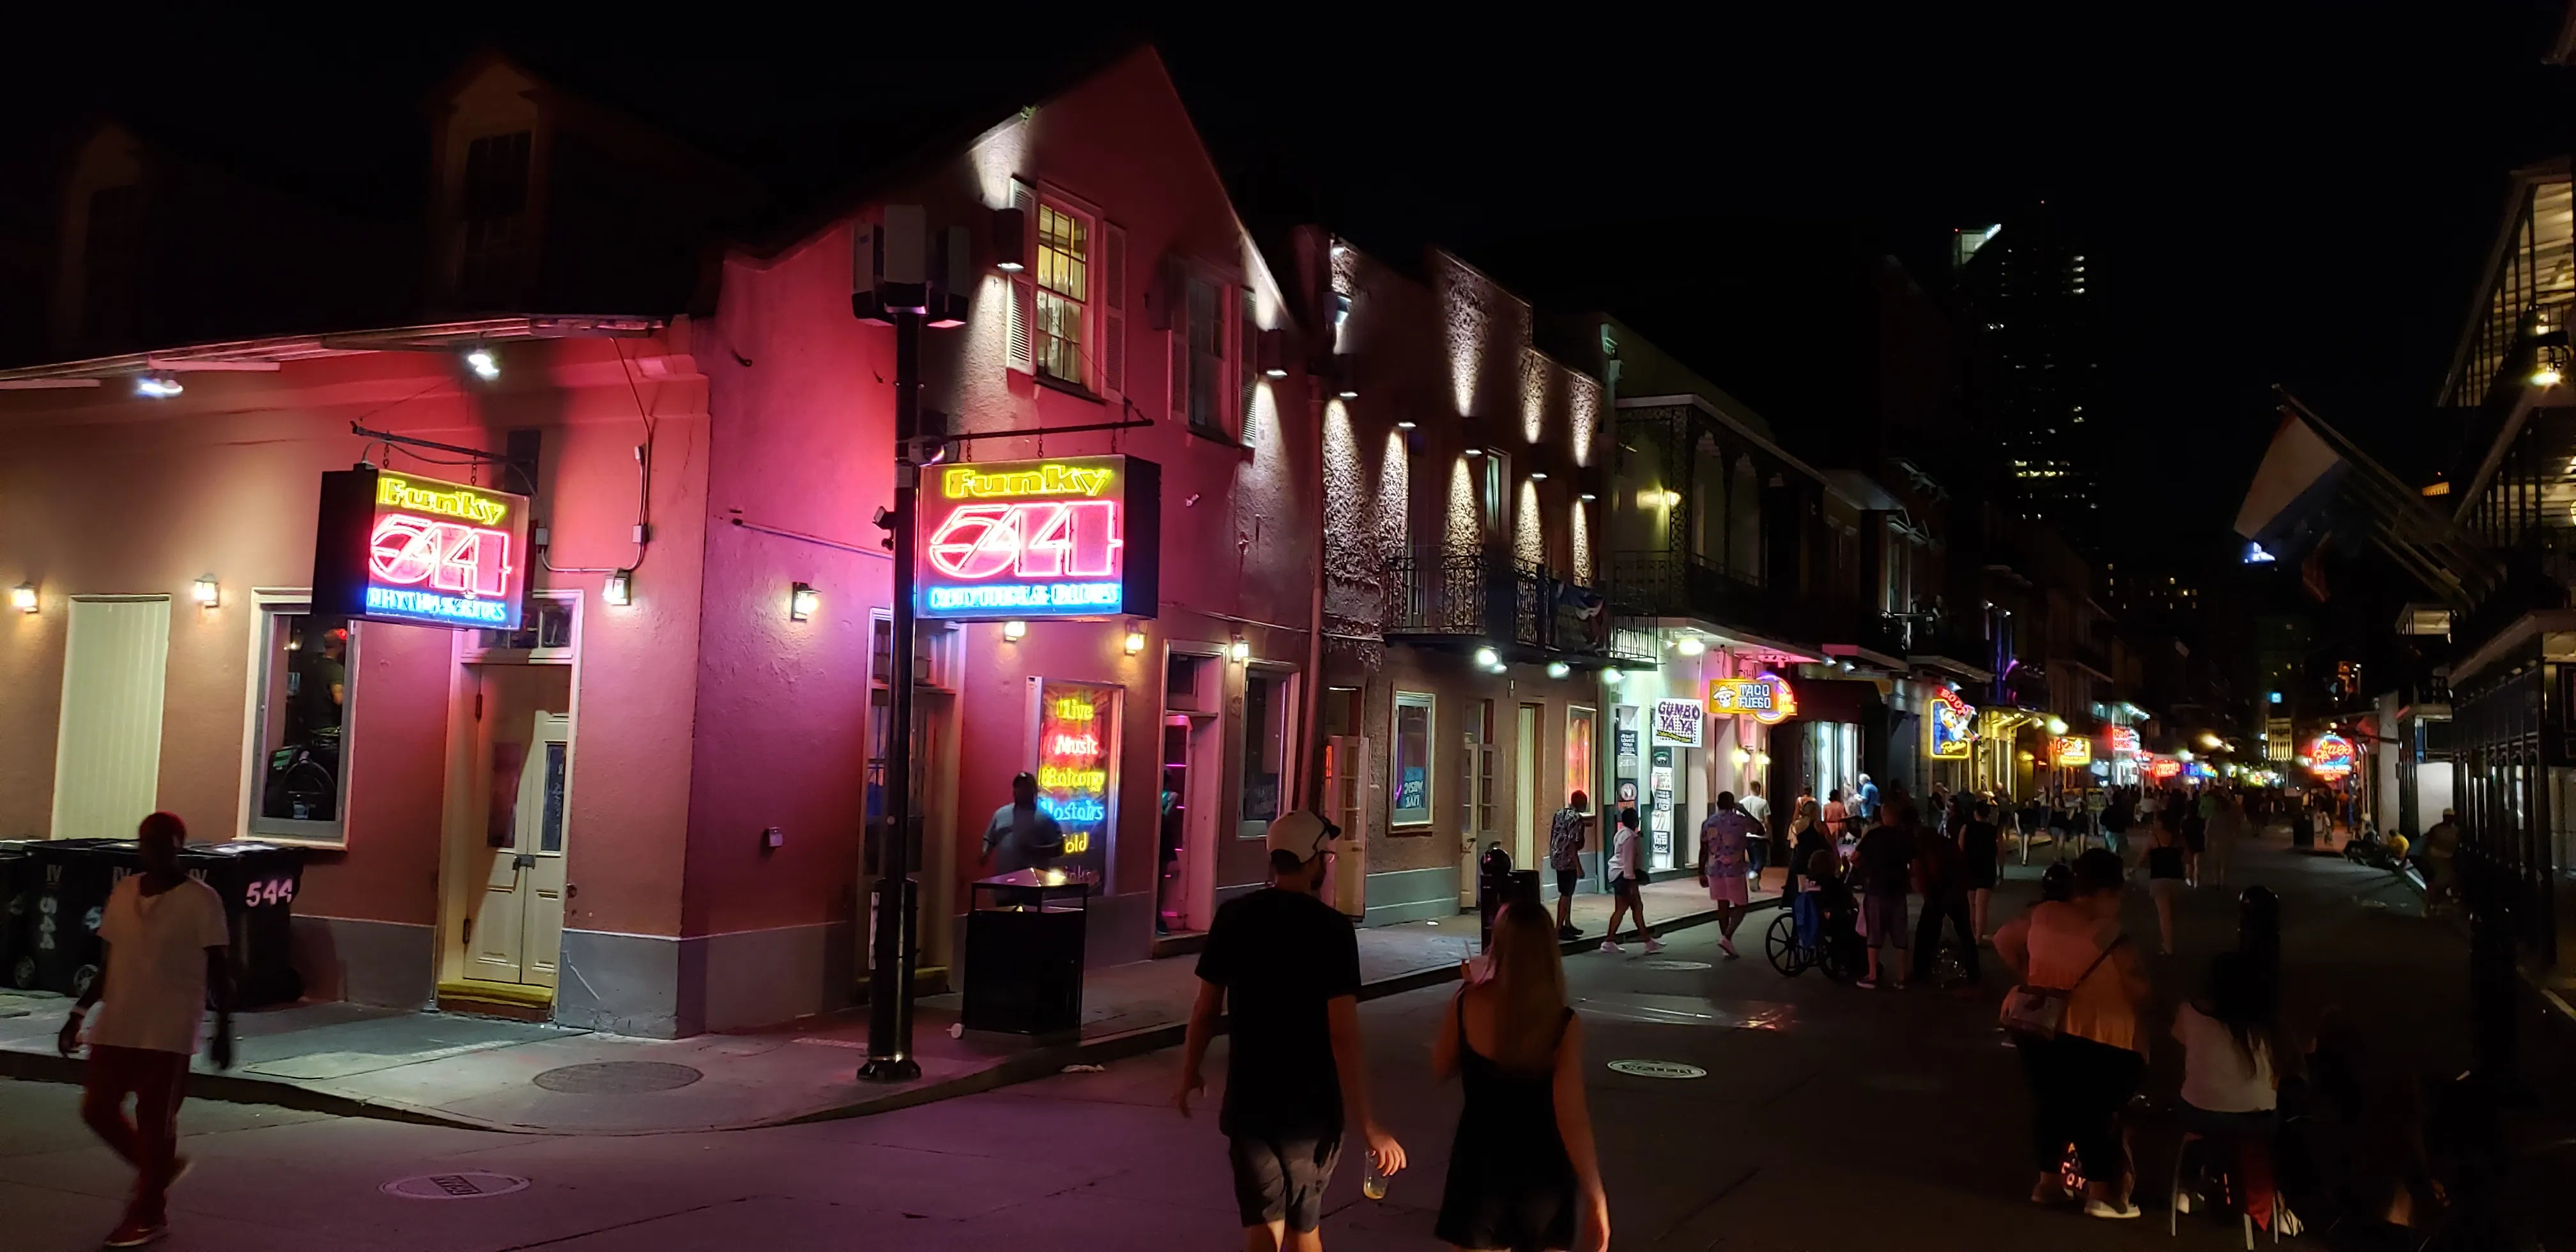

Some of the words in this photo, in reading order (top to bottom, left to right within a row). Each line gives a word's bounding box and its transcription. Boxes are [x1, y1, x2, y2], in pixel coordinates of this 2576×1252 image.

[945, 464, 1112, 498] Funky
[379, 477, 509, 524] Funky
[928, 500, 1124, 579] 544
[368, 514, 512, 597] 544
[367, 587, 441, 615] RHYTHM
[1738, 684, 1770, 696] TACO
[1738, 696, 1770, 709] FUEGO
[1658, 701, 1700, 721] GUMBO
[1660, 715, 1675, 731] YA
[1680, 719, 1694, 735] YA
[1054, 733, 1098, 756] Music
[1065, 832, 1087, 853] old
[246, 878, 293, 908] 544
